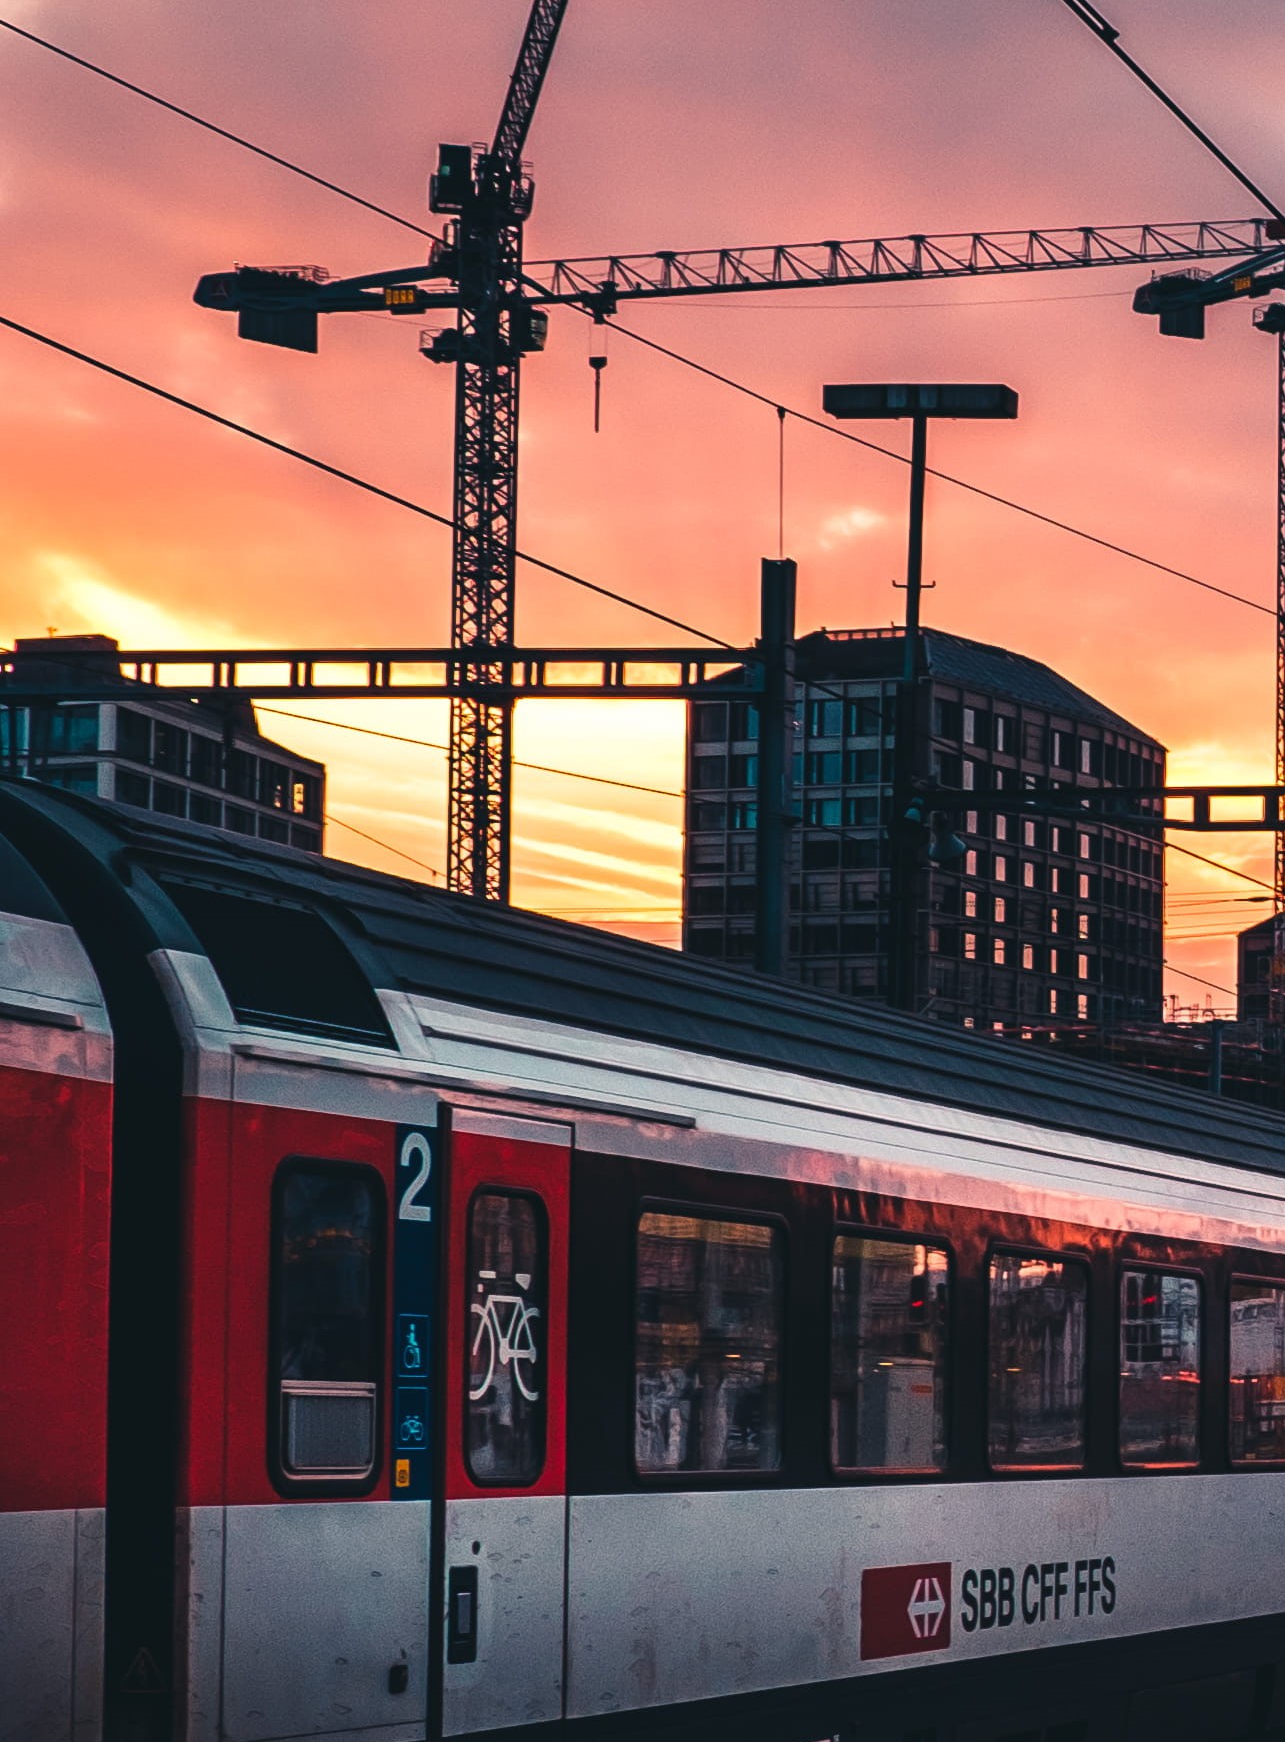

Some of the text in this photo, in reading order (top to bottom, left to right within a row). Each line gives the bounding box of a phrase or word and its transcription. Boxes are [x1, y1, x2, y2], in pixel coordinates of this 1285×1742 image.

[399, 1132, 431, 1221] 2
[960, 1556, 1116, 1633] SBB CFF FFS
